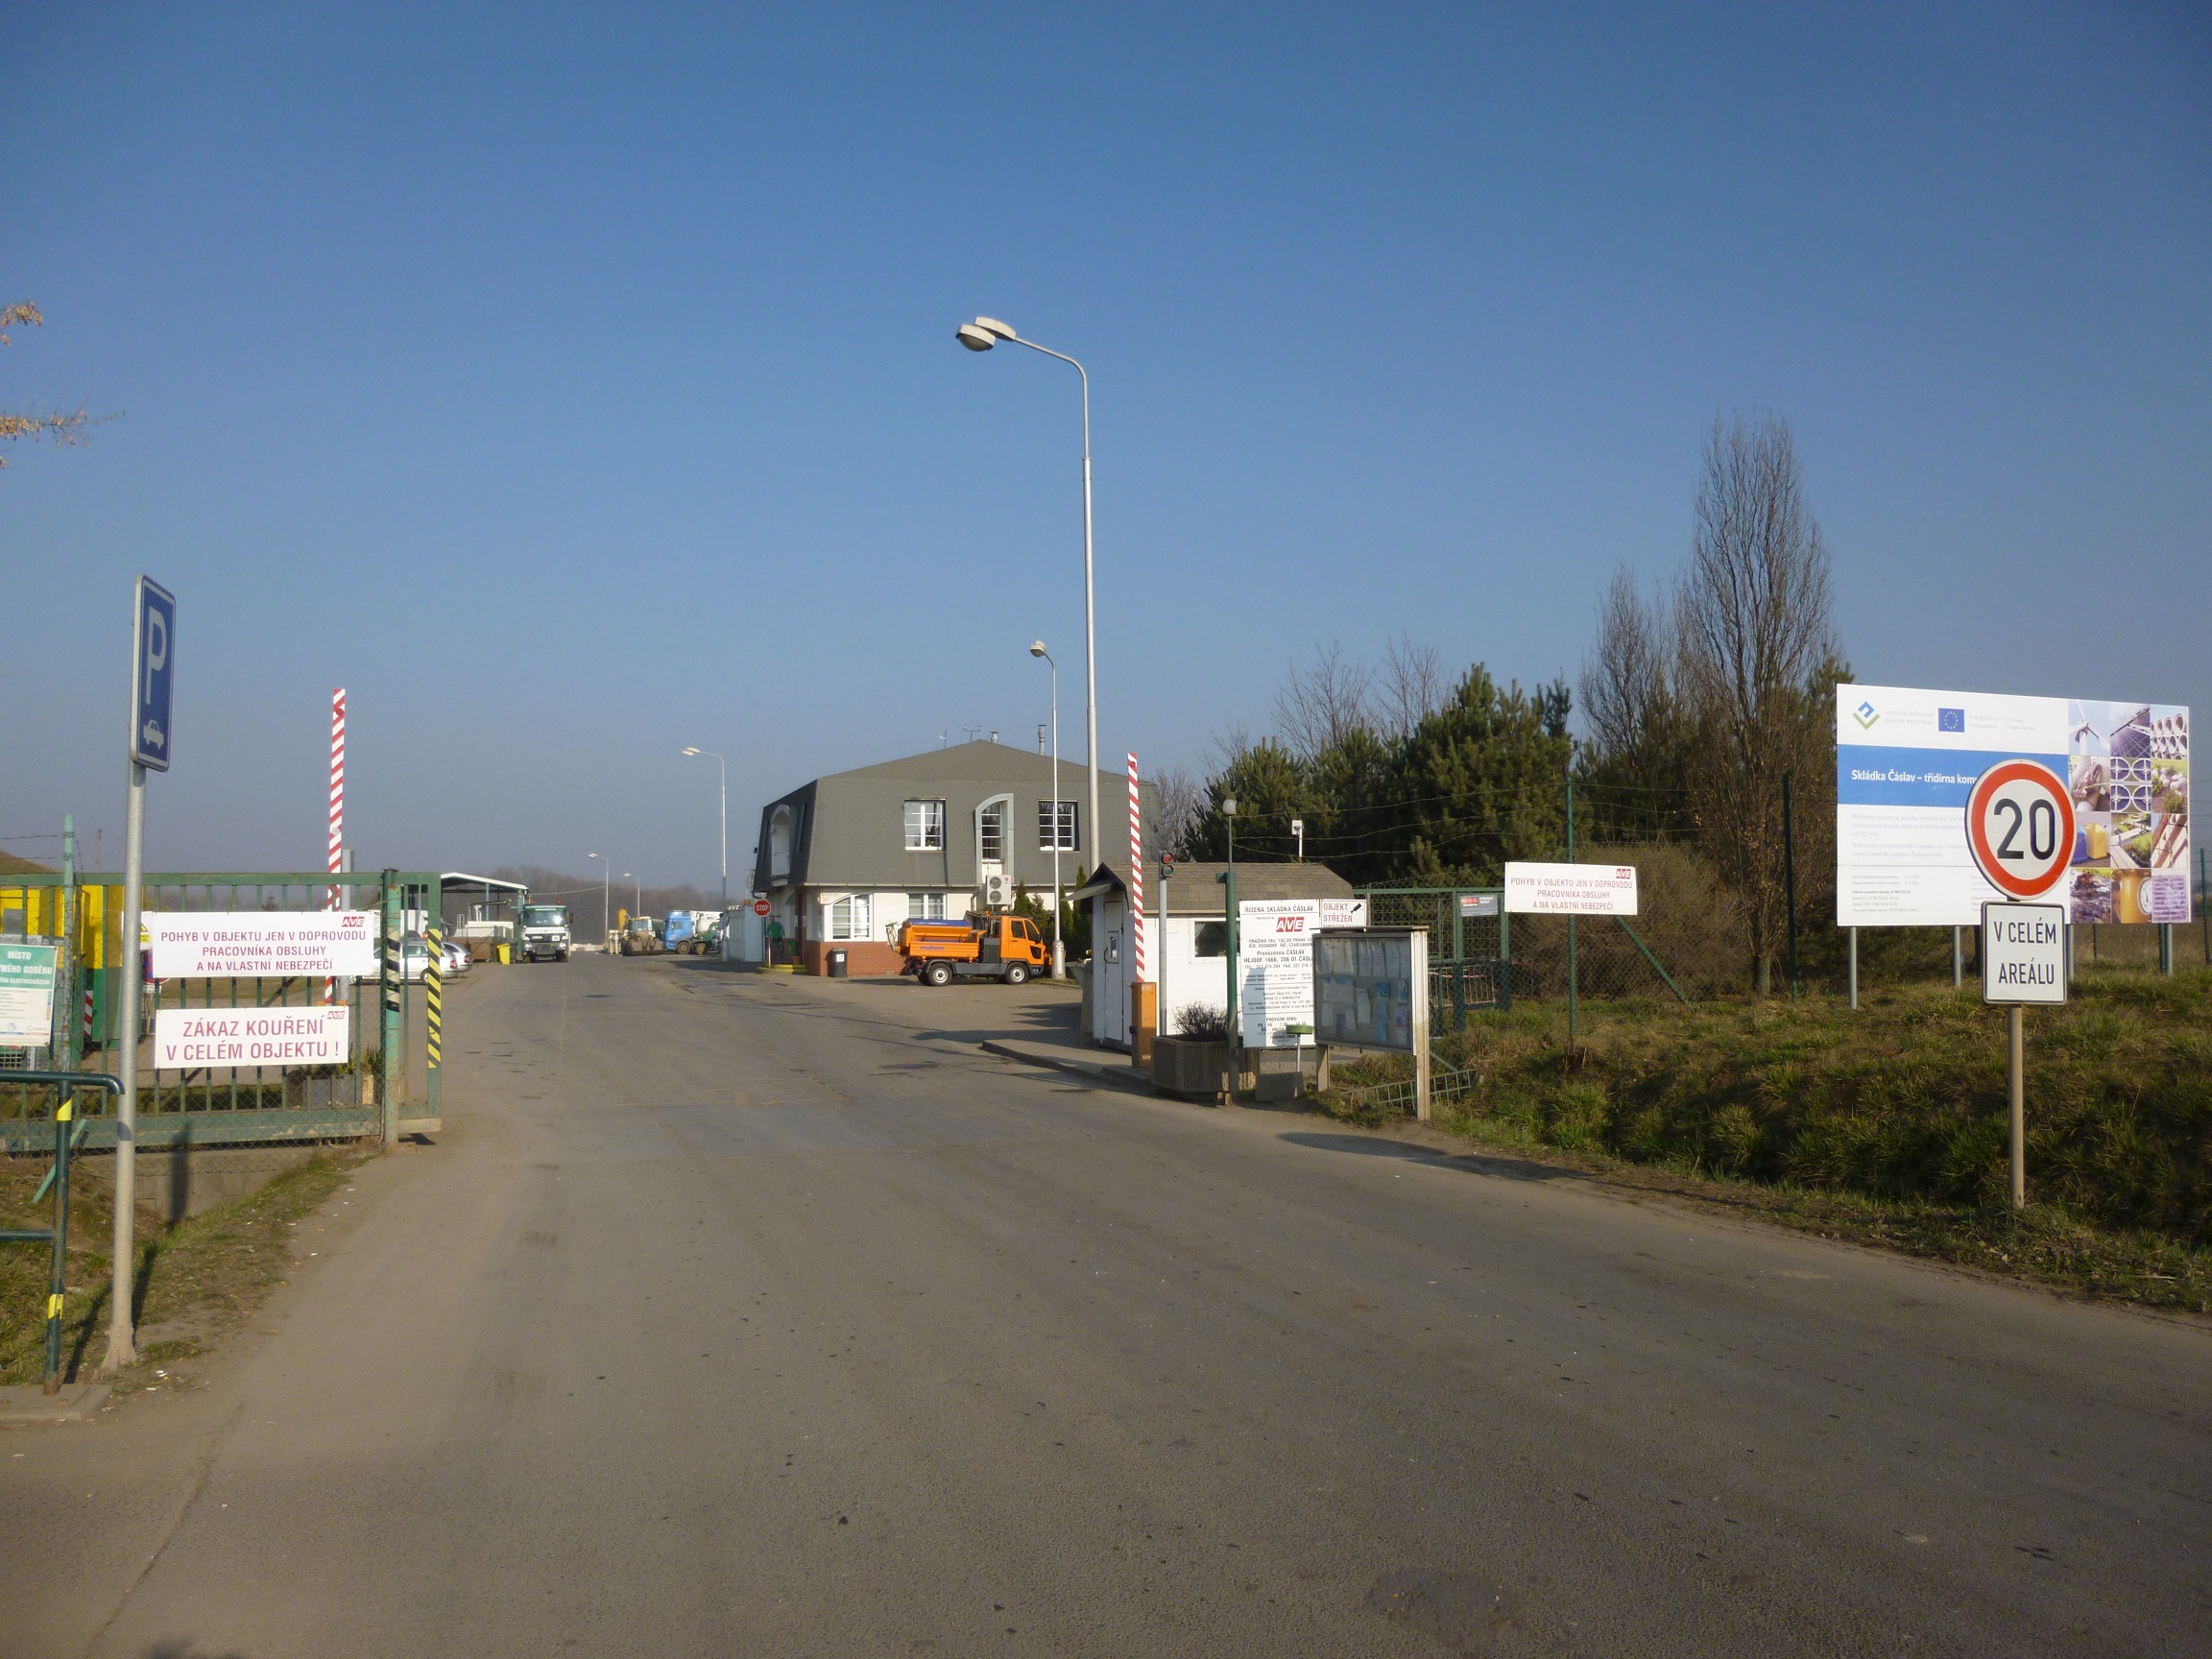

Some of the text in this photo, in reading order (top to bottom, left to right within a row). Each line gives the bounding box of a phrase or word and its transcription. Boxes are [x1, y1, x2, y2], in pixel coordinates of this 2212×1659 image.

[146, 606, 167, 705] P
[1851, 770, 1886, 781] Skládka
[1887, 768, 1915, 781] Čáslav
[1924, 773, 1956, 783] třídírna
[1993, 799, 2056, 860] 20
[1616, 868, 1631, 879] AVE
[1544, 878, 1574, 887] OBJEKTU
[1595, 879, 1632, 889] DOPROVODU
[1537, 889, 1580, 899] PRACOVNÍKA
[1551, 901, 1579, 909] VLASTNÍ
[342, 916, 365, 927] AVE
[1323, 913, 1353, 922] STŘEŽEN
[1276, 917, 1304, 932] AVE
[1993, 917, 2056, 944] V CELÉM
[161, 931, 366, 942] POHYB V OBJEKTU JEN V DOPROVODU
[8, 949, 32, 960] MÍSTO
[203, 945, 326, 956] PRACOVNÍKA OBSLUHY
[197, 958, 333, 971] A NA VLASTNÍ NEBEZPEČÍ
[1998, 957, 2055, 985] AREÁLU
[326, 1010, 346, 1020] AVE
[182, 1015, 325, 1037] ZÁKAZ KOUŘENÍ
[166, 1045, 177, 1061] V
[183, 1040, 242, 1060] CELÉM
[251, 1042, 326, 1059] OBJEKTU
